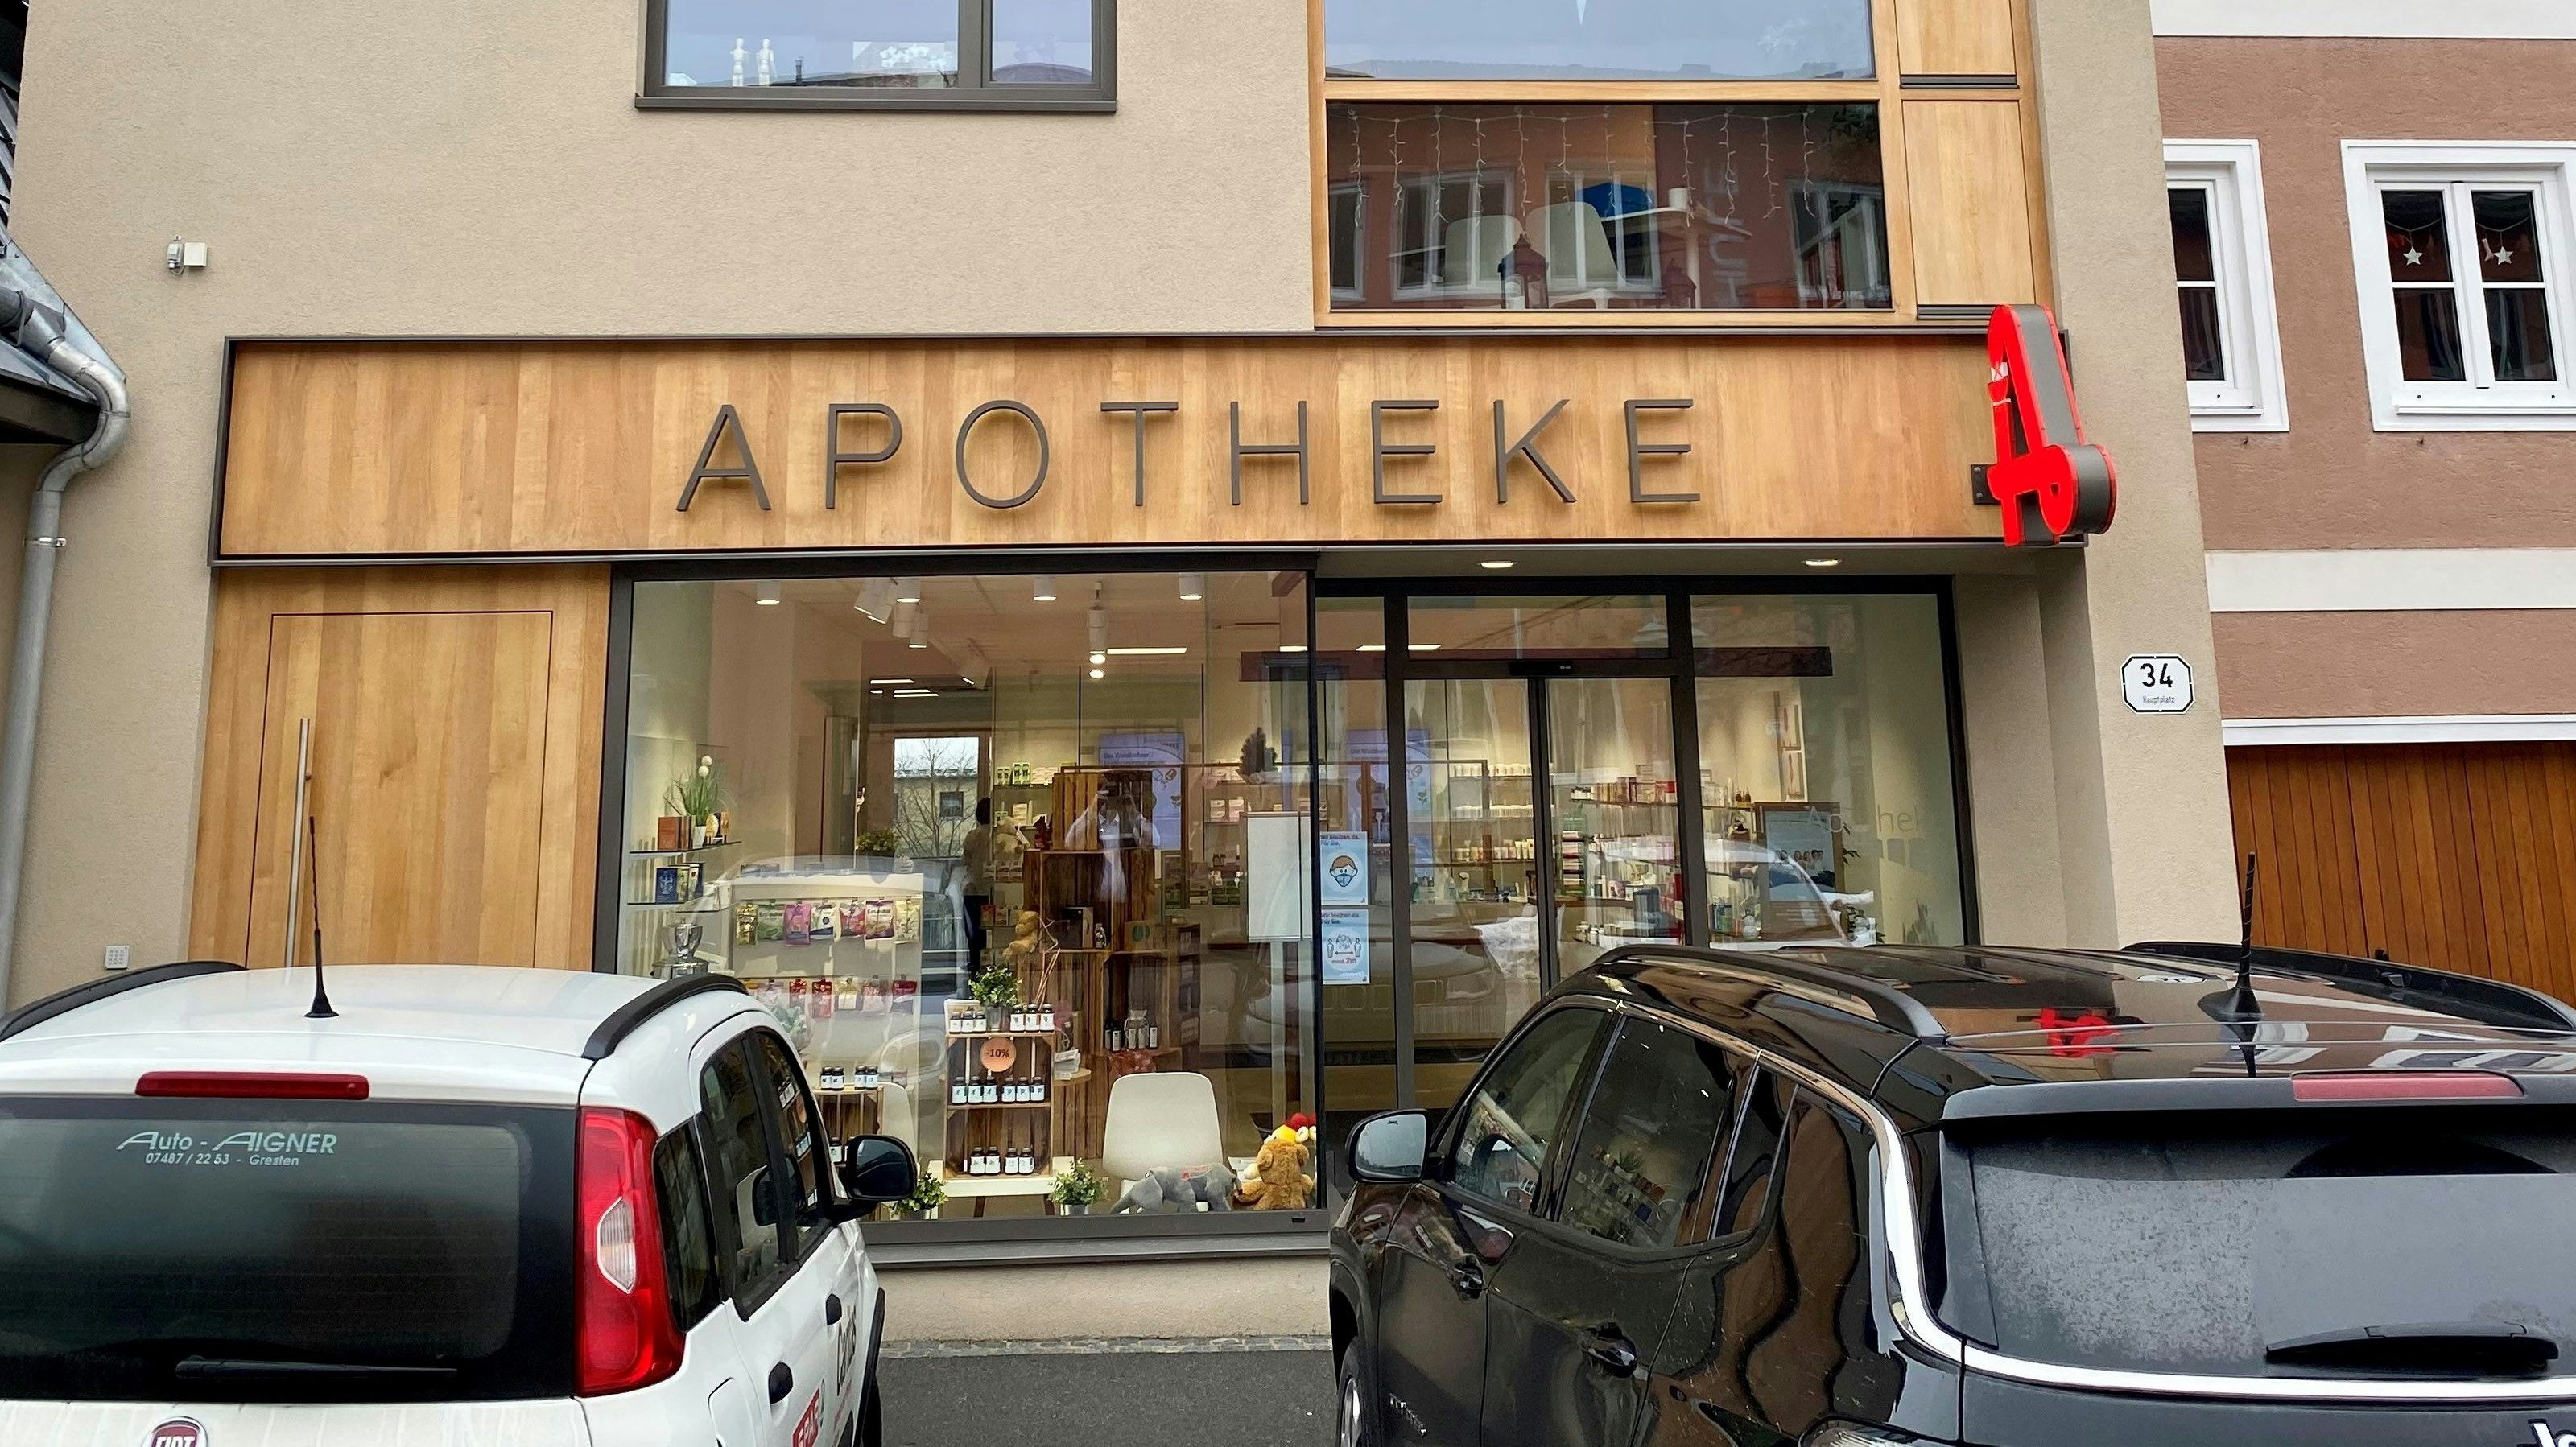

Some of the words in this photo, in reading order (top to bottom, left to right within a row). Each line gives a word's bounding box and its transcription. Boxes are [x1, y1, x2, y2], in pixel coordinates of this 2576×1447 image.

[676, 399, 1701, 511] APOTHEKE
[2140, 663, 2173, 688] 34
[985, 1048, 1010, 1058] -10%
[116, 1131, 193, 1151] Auto
[212, 1132, 338, 1154] AIGNER
[145, 1152, 184, 1165] 07487
[196, 1153, 211, 1165] 22
[214, 1154, 230, 1165] 53
[249, 1154, 299, 1166] Gresten
